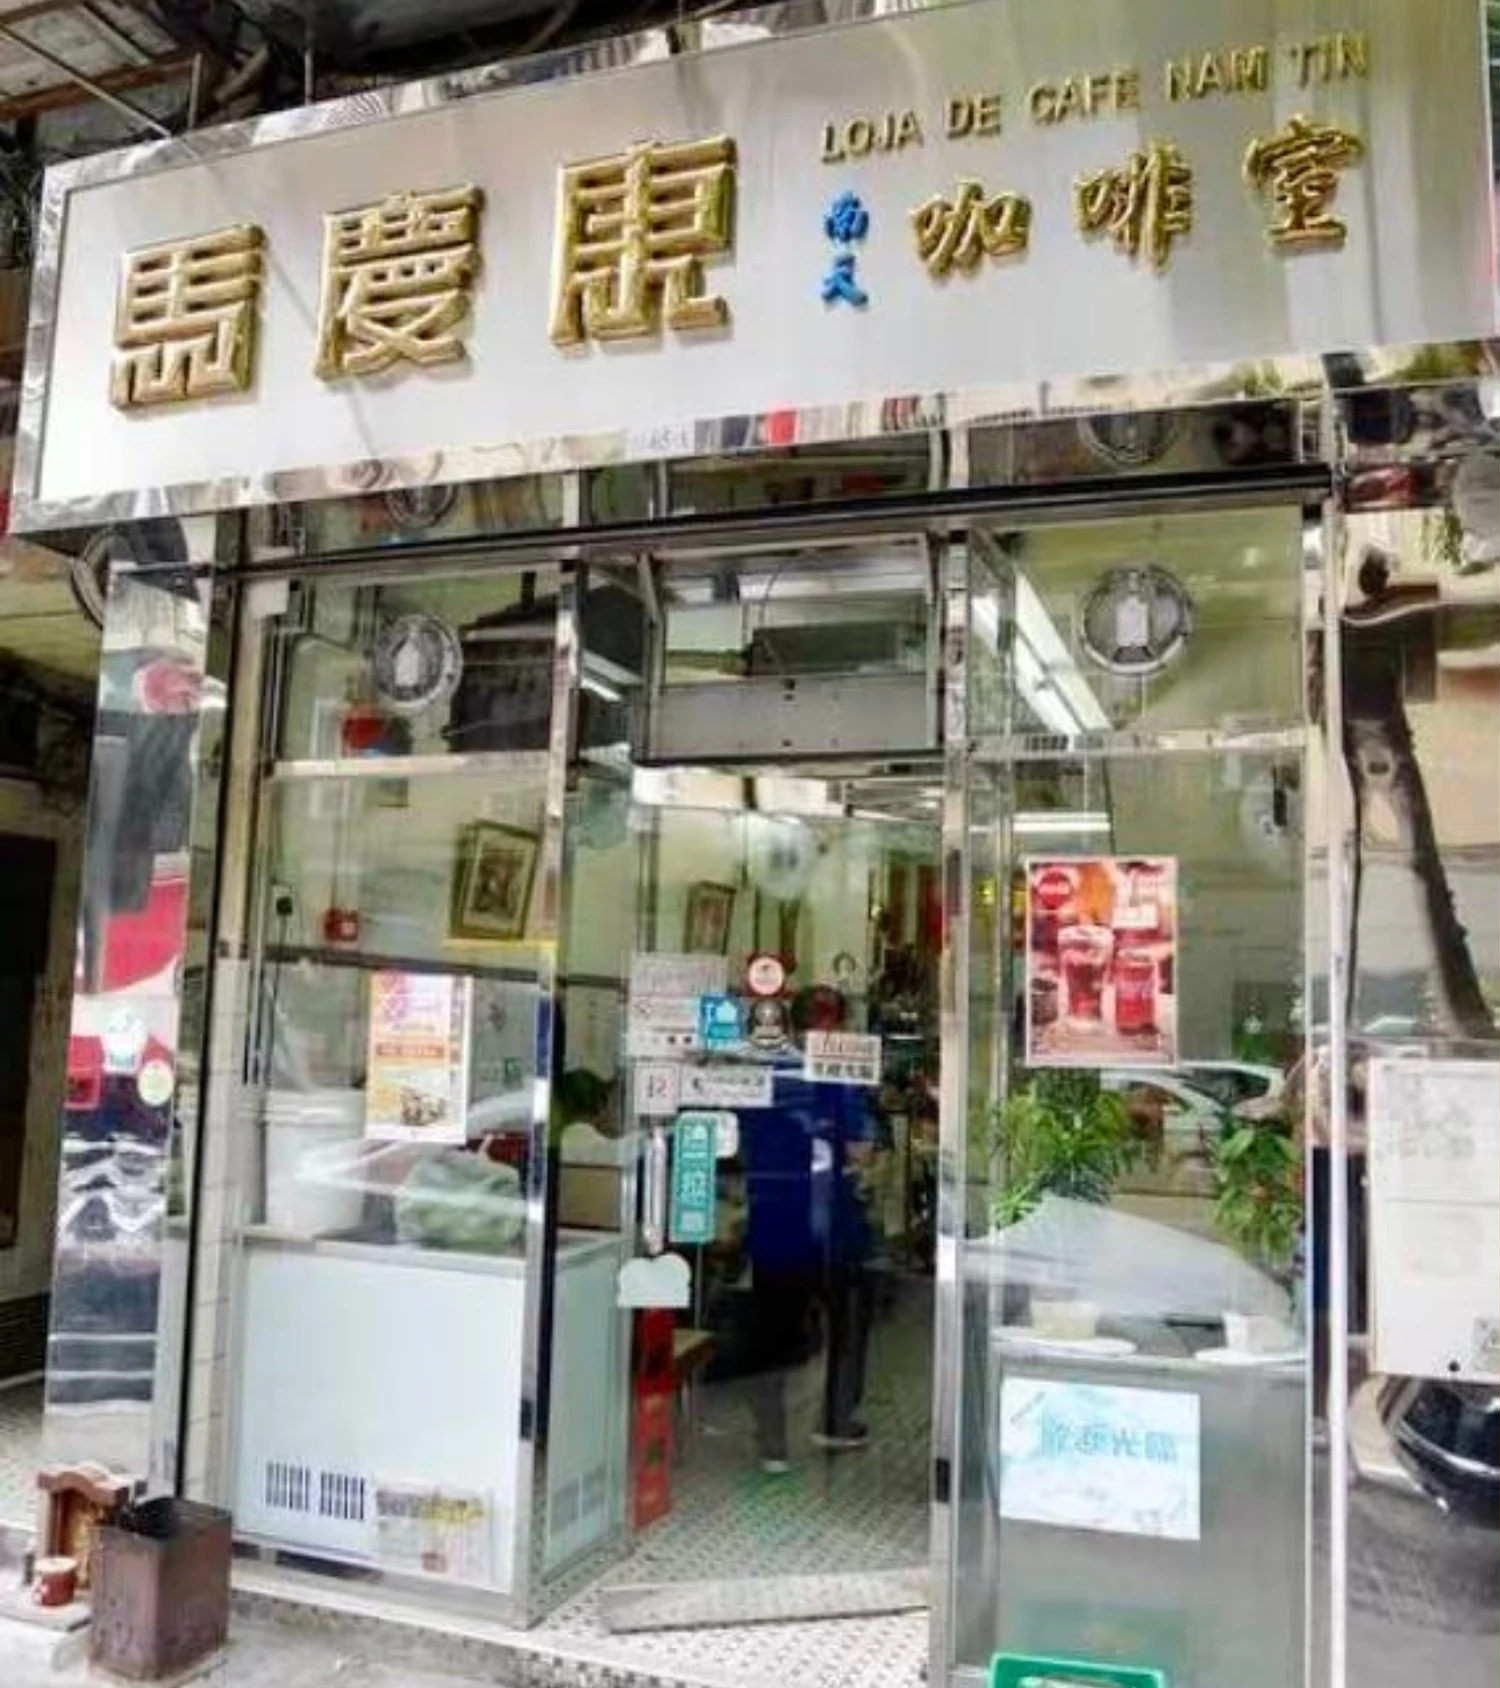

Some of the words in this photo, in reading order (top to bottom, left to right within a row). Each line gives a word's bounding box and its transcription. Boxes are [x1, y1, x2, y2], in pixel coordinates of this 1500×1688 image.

[821, 108, 924, 164] LOJA
[945, 92, 1001, 140] DE
[1026, 66, 1140, 127] CAFE
[1165, 45, 1269, 102] NAM
[1290, 34, 1369, 90] TIN
[905, 112, 1366, 282] 咖啡室
